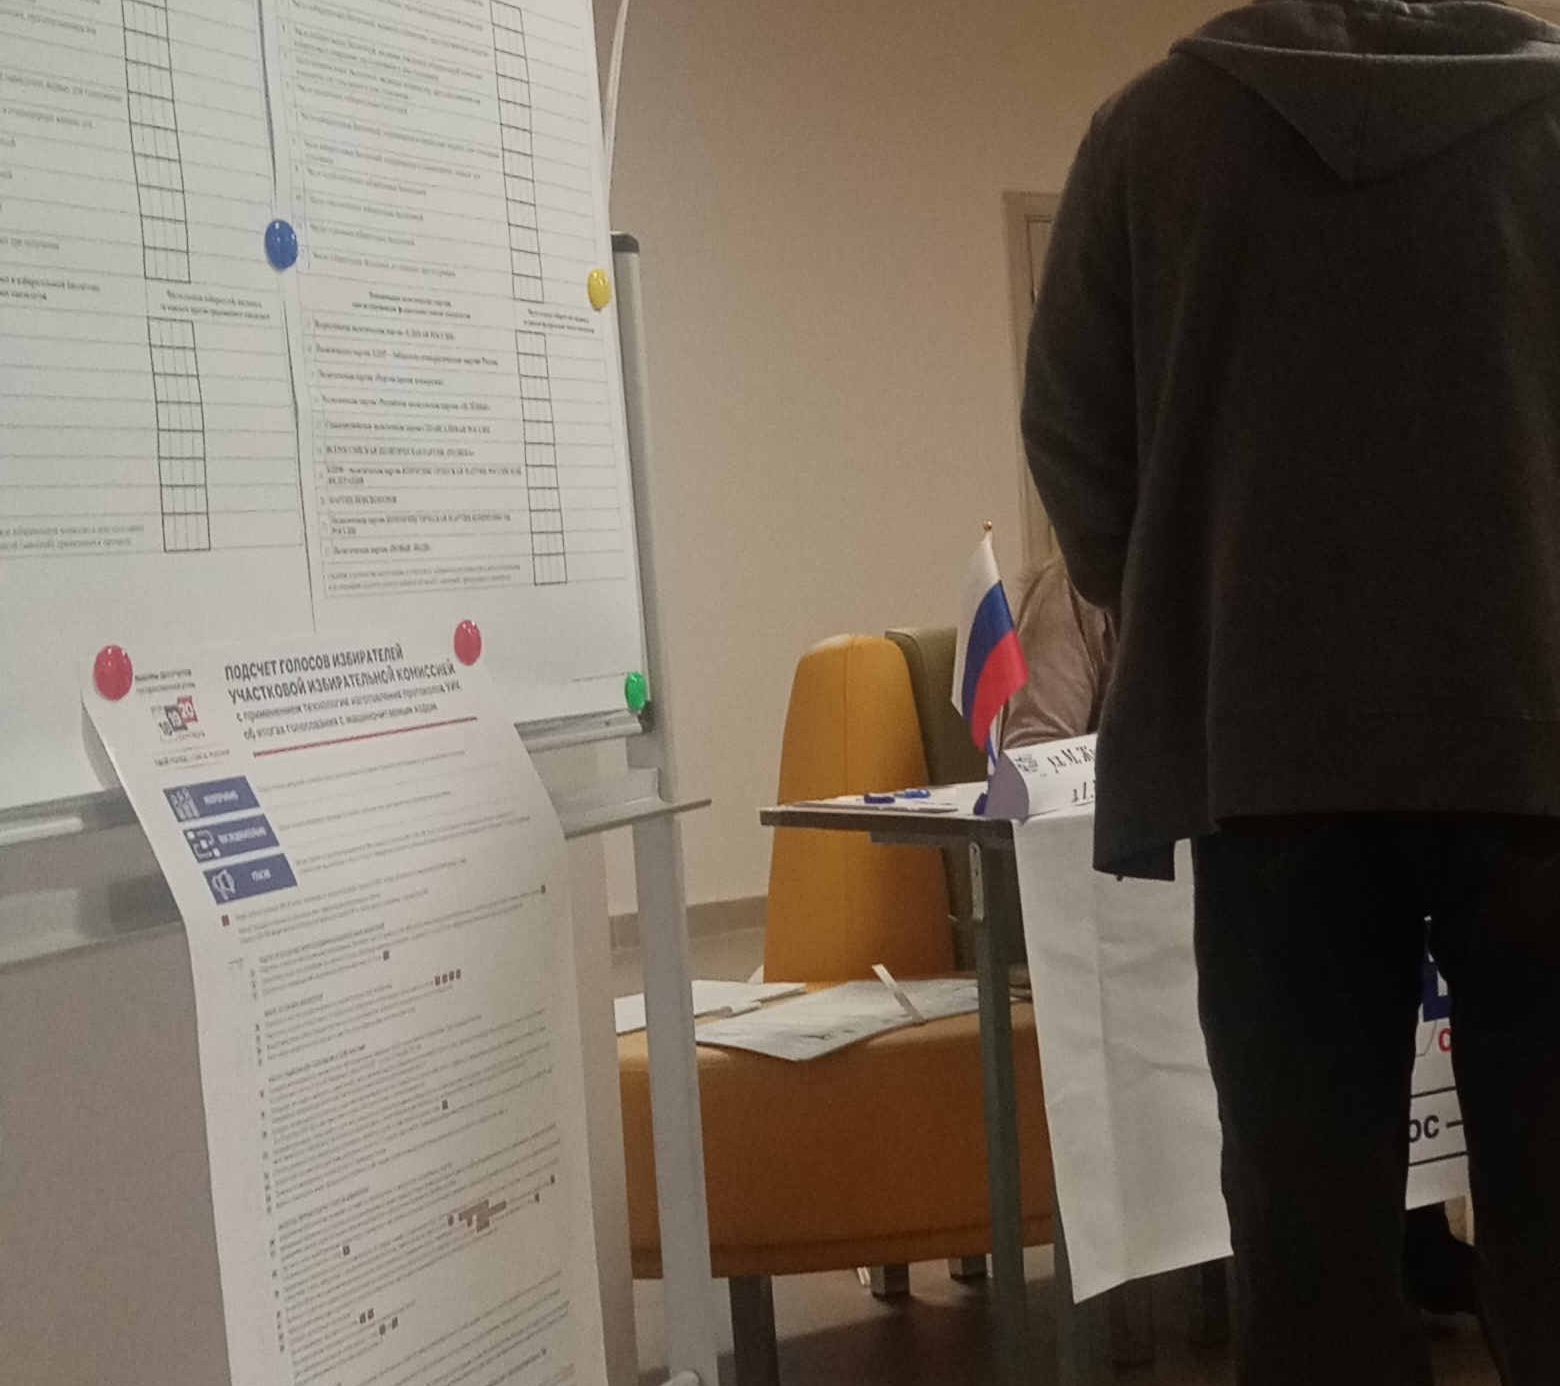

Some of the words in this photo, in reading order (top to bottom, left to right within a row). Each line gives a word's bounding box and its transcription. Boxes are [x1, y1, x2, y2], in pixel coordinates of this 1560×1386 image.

[225, 659, 278, 681] ПОДСЧЕТ
[279, 654, 331, 674] ГОЛОСОВ
[332, 643, 403, 670] ИЗБИРАТЕЛЕЙ
[228, 678, 306, 705] УЧАСТКОВОЙ
[307, 665, 396, 695] ИЗБИРАТЕЛЬНОЙ
[397, 658, 457, 681] КОМИССИЕЙ
